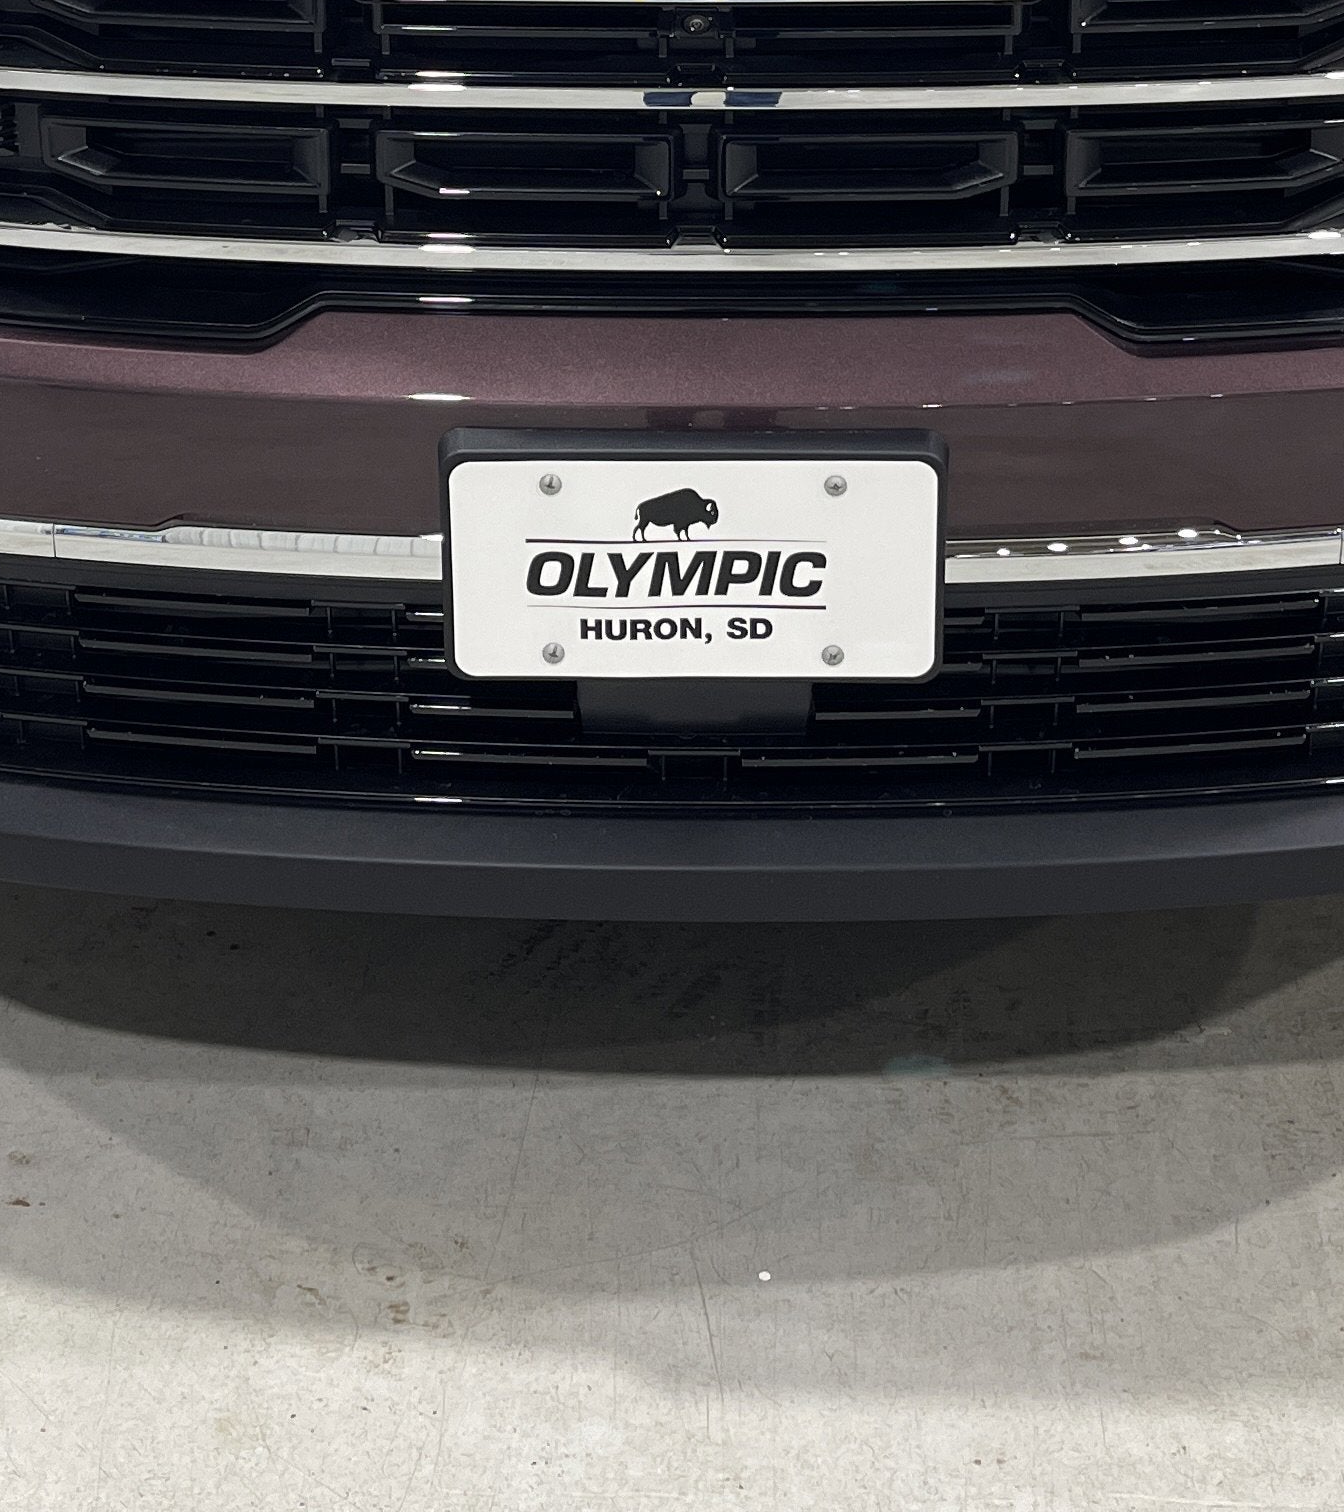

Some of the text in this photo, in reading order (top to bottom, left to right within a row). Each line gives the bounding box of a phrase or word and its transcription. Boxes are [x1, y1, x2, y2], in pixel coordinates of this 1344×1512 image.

[525, 550, 827, 598] OLYMPIC
[579, 617, 774, 644] HURON, SD
